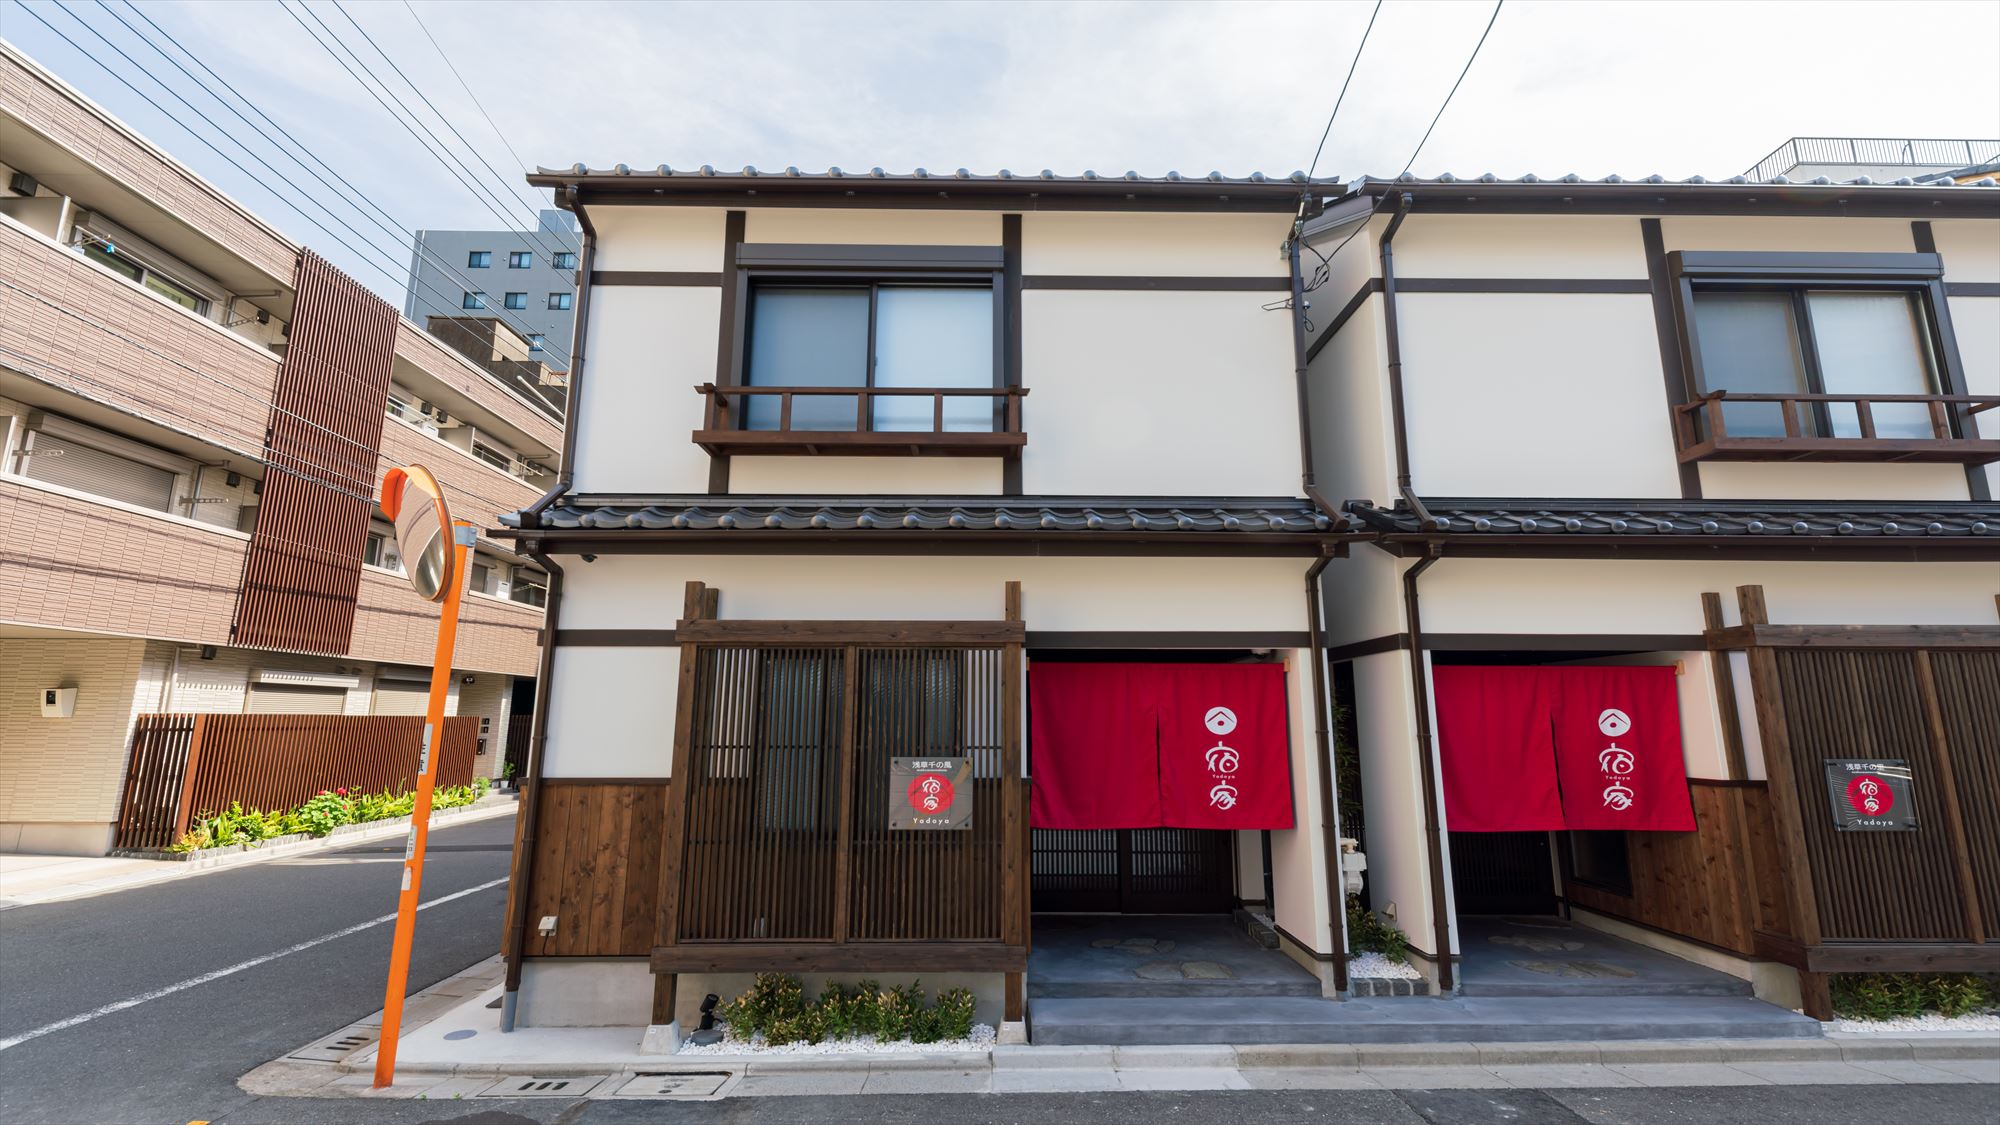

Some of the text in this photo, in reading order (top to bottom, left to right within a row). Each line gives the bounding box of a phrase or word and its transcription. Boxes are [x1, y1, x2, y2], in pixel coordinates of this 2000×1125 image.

[912, 761, 952, 769] 浅草千の風
[913, 817, 950, 825] Yadoya
[1856, 819, 1894, 827] Yadoya
